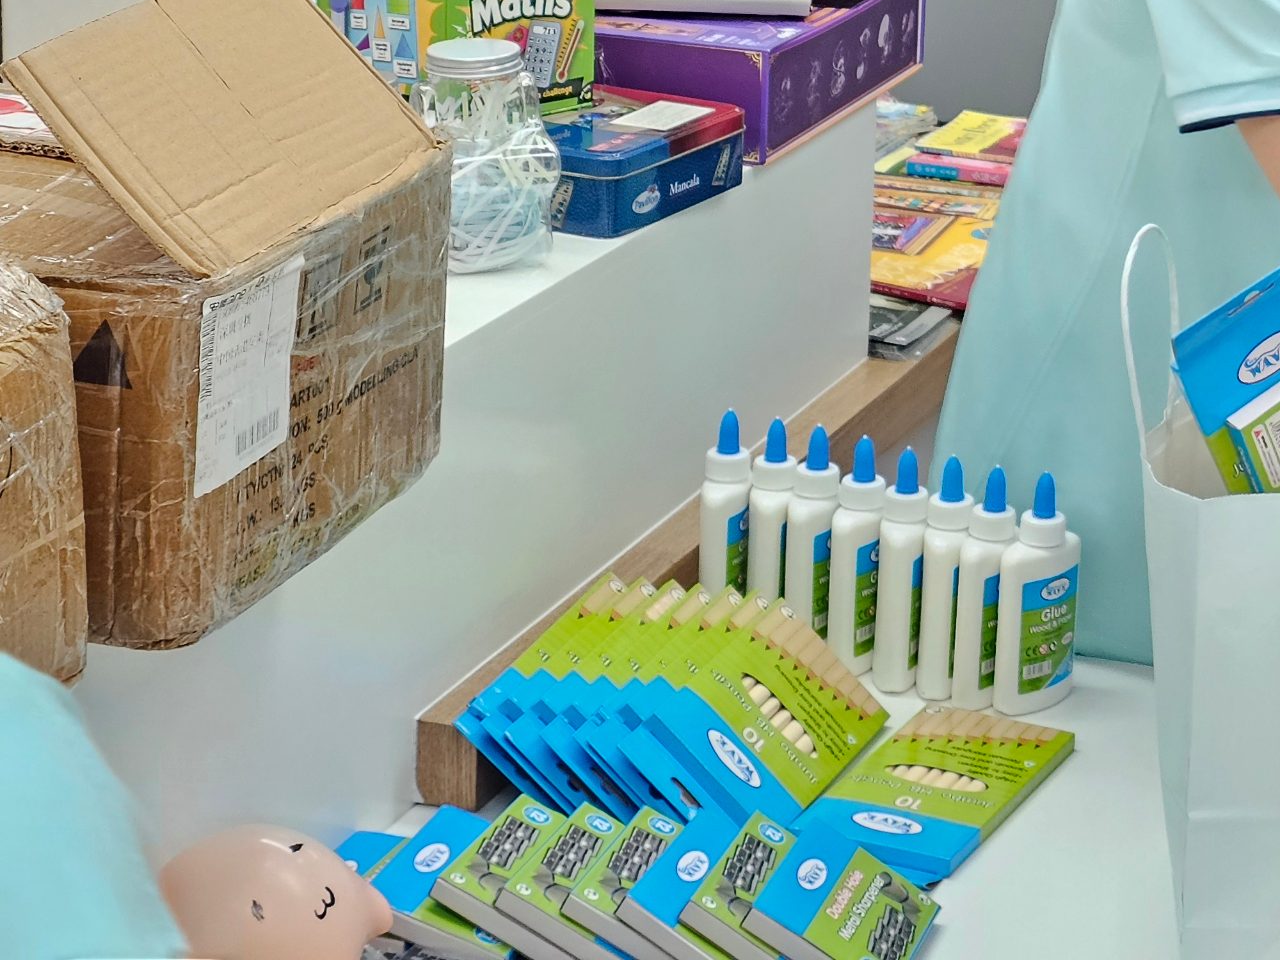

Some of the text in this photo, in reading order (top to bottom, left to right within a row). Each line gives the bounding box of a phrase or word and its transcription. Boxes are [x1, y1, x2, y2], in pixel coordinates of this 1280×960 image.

[669, 173, 700, 196] Mancala
[1041, 604, 1067, 622] Glue
[824, 867, 865, 920] Double Hole
[836, 873, 890, 942] Metal Sharpener
